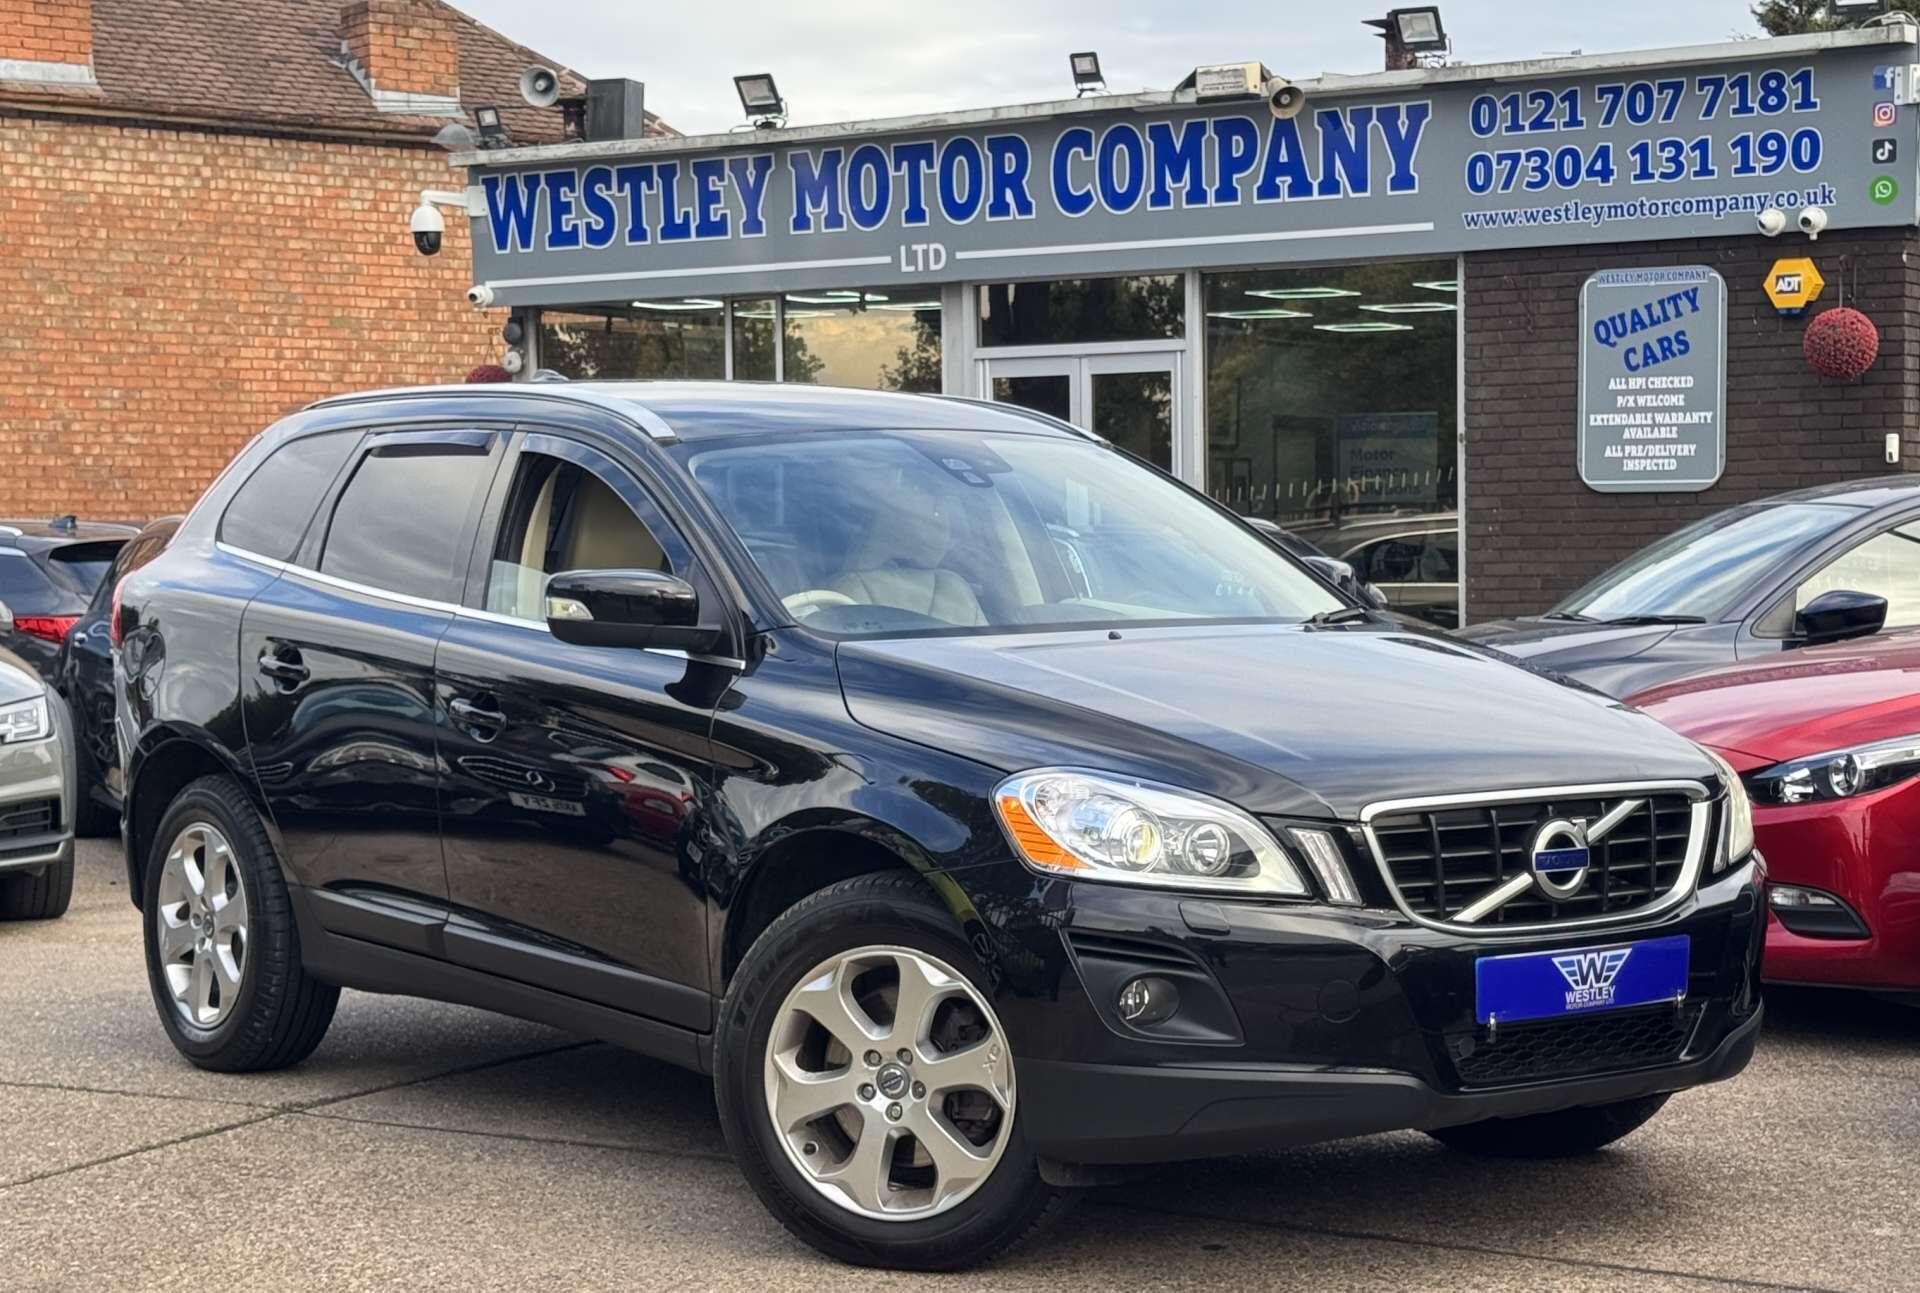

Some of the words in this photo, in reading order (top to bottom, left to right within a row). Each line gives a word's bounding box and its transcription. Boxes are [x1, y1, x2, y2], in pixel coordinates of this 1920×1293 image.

[1469, 87, 1585, 138] 0121
[1597, 77, 1687, 128] 707
[1697, 66, 1820, 121] 7181
[1465, 142, 1616, 195] 07304
[1627, 135, 1718, 184] 131
[1729, 127, 1823, 176] 190
[479, 153, 775, 254] WESTLEY
[787, 133, 1036, 235] MOTOR
[1050, 100, 1432, 217] COMPANY
[1463, 183, 1836, 230] www.westleymotorcompany.co.uk
[899, 242, 948, 273] LTD
[1774, 276, 1802, 293] ADT
[1593, 286, 1700, 348] QUALITY
[1623, 330, 1690, 372] CARS
[1608, 377, 1627, 390] ALL
[1628, 376, 1647, 389] HPI
[1647, 376, 1694, 389] CHECKED
[1616, 395, 1635, 408] P/X
[1636, 394, 1685, 407] WELCOME
[1589, 412, 1653, 426] EXTENDABLE
[1654, 411, 1713, 425] WARRANTY
[1622, 426, 1678, 439] AVAILABLE
[1350, 448, 1393, 462] Motor
[1604, 445, 1623, 458] ALL
[1624, 444, 1697, 457] PRE/DELIVERY
[1622, 458, 1678, 471] INSPECTED
[1565, 985, 1616, 1003] WESTLEY
